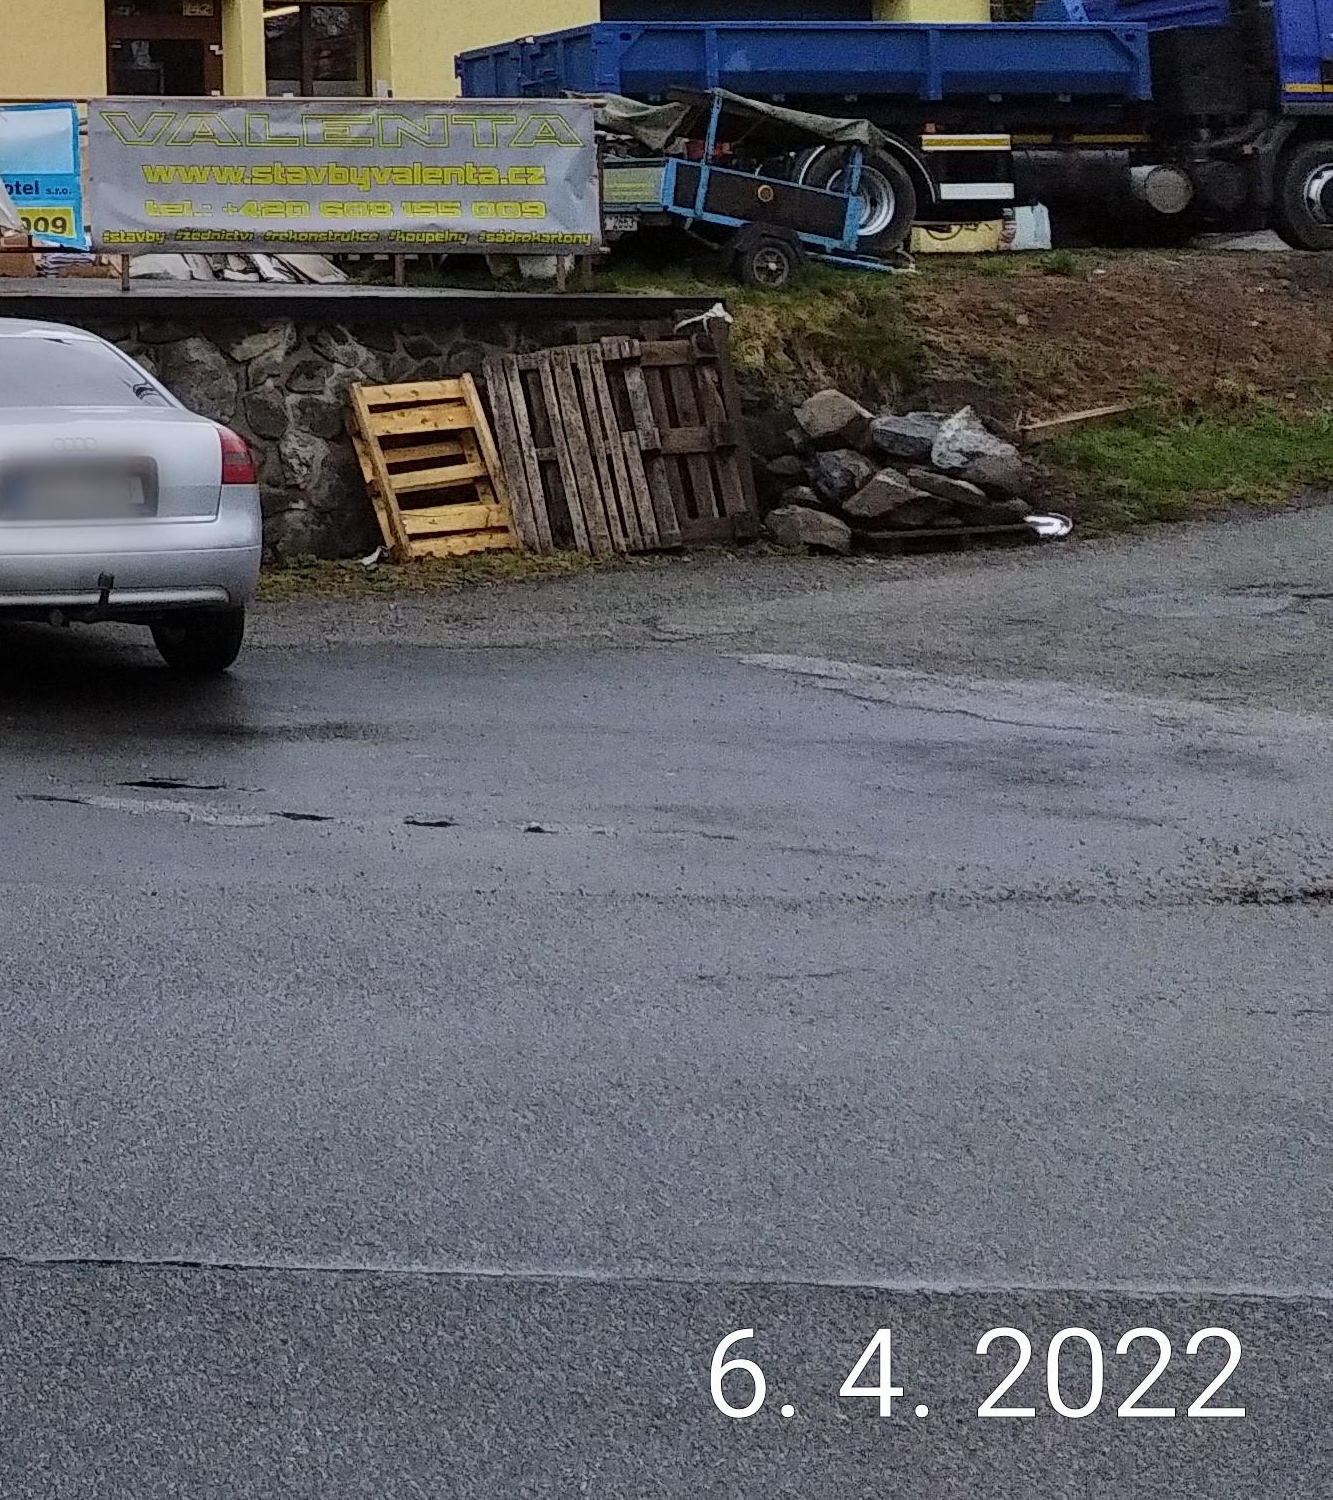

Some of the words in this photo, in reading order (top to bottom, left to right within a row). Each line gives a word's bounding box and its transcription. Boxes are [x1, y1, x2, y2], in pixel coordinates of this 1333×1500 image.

[100, 111, 584, 148] VALENTA
[141, 161, 547, 192] www.stavbyvalenta.cz
[46, 187, 72, 195] s.r.o.
[221, 201, 310, 218] +420
[319, 201, 394, 219] 608
[401, 201, 462, 218] 155
[471, 201, 547, 219] 009
[102, 229, 166, 244] #stavby
[263, 229, 380, 243] #rekonstrukce
[388, 229, 469, 244] #koupelny
[478, 229, 593, 246] #sádrokartony
